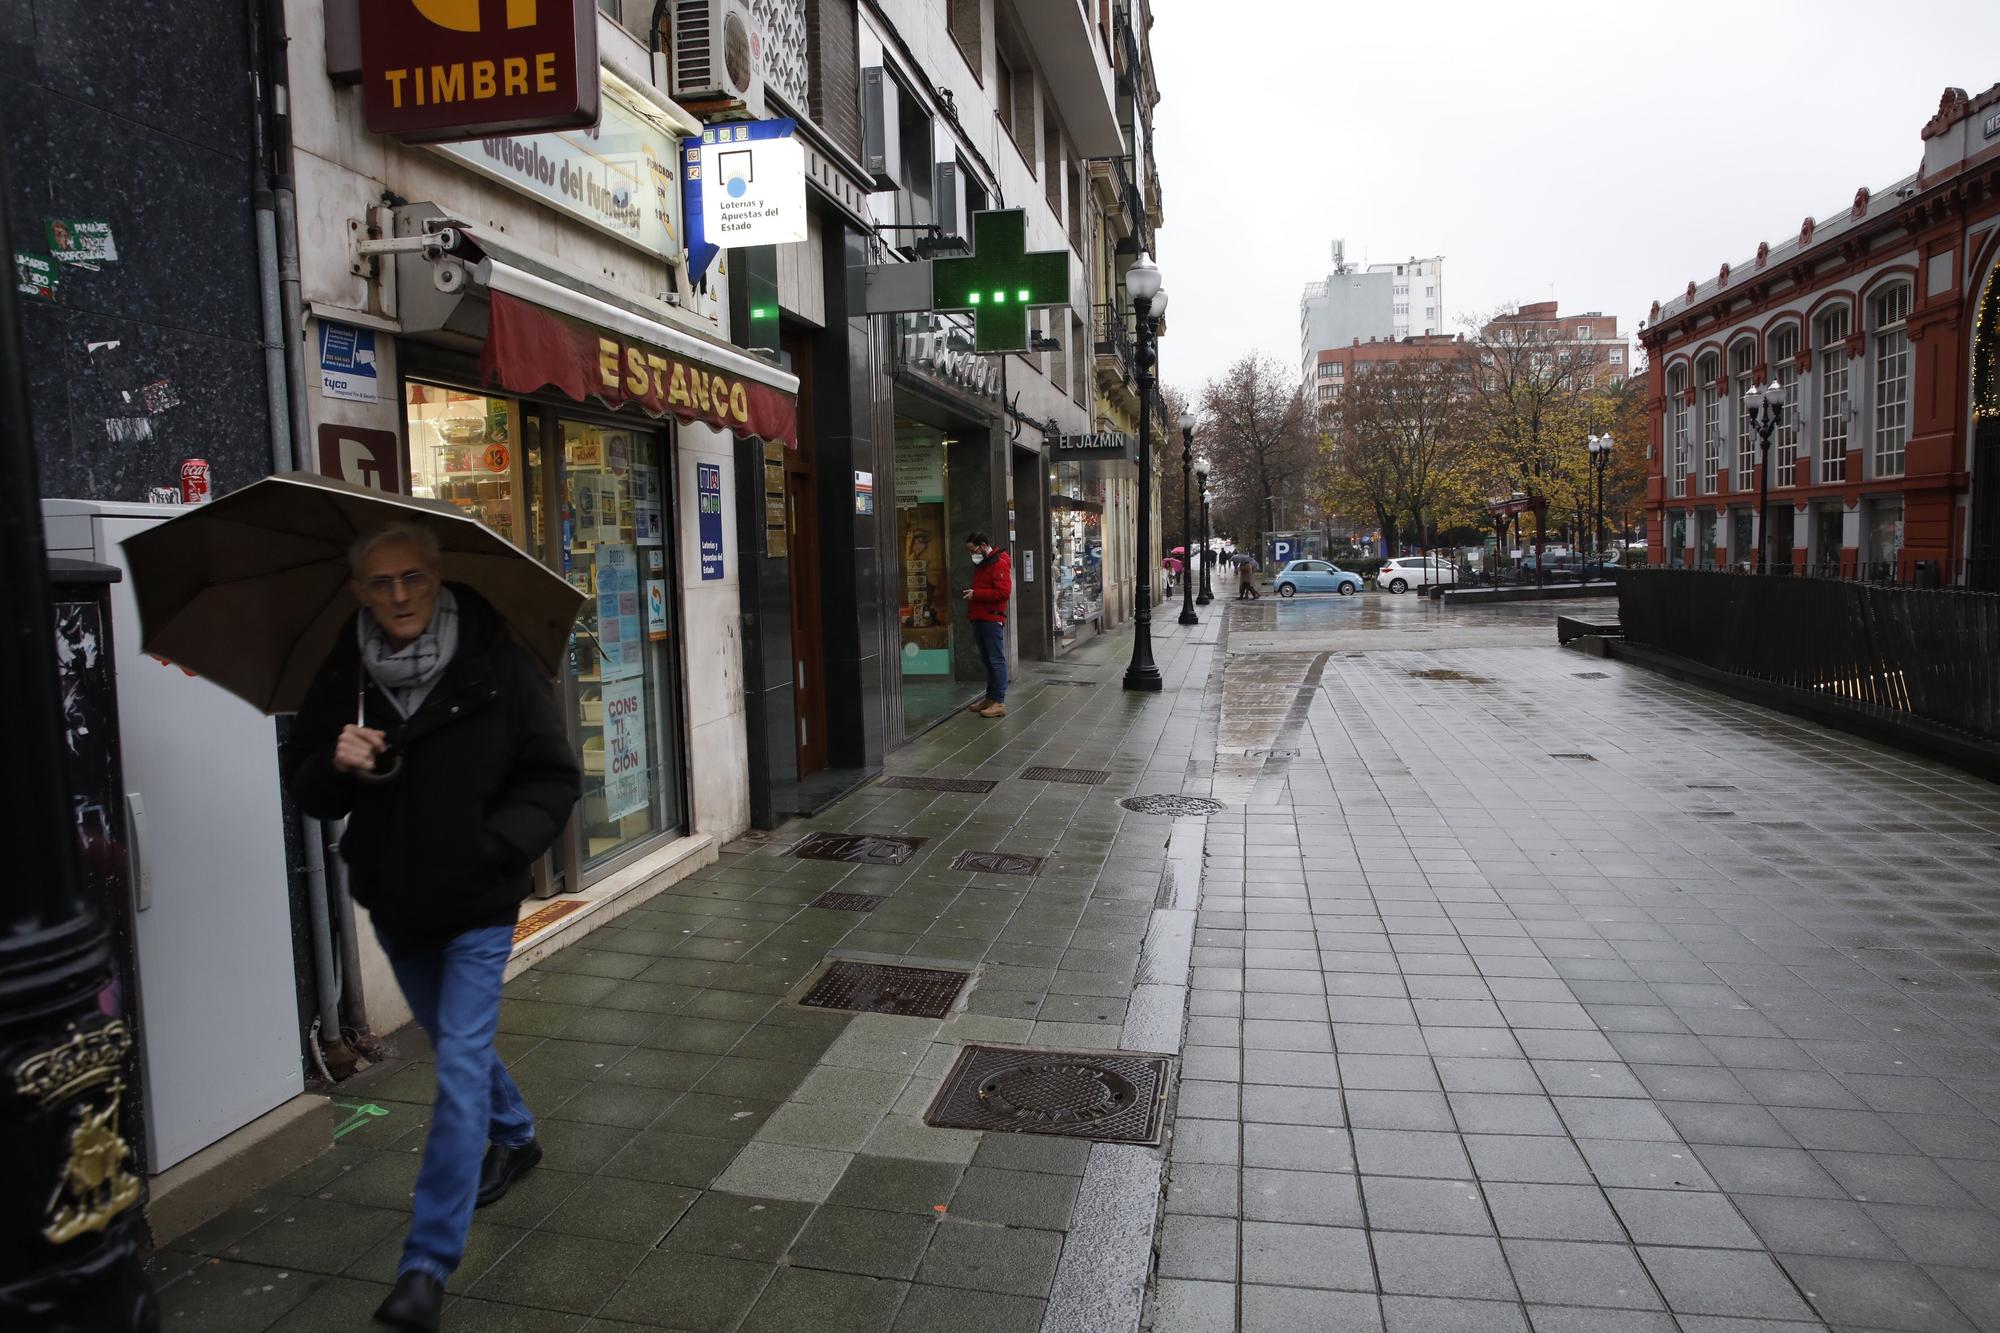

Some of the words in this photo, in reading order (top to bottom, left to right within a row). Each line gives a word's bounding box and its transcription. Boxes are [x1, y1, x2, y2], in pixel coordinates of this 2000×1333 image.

[385, 52, 557, 108] TIMBRE
[560, 158, 584, 202] del
[758, 200, 764, 208] y
[721, 210, 762, 222] Apuestas
[765, 208, 779, 218] del
[721, 222, 752, 232] Estado
[323, 376, 347, 391] tyco
[599, 338, 748, 423] ESTANCO
[1060, 434, 1073, 449] EL
[1275, 542, 1290, 560] P
[608, 695, 638, 717] CONS
[615, 718, 624, 735] TI
[611, 737, 624, 755] TU
